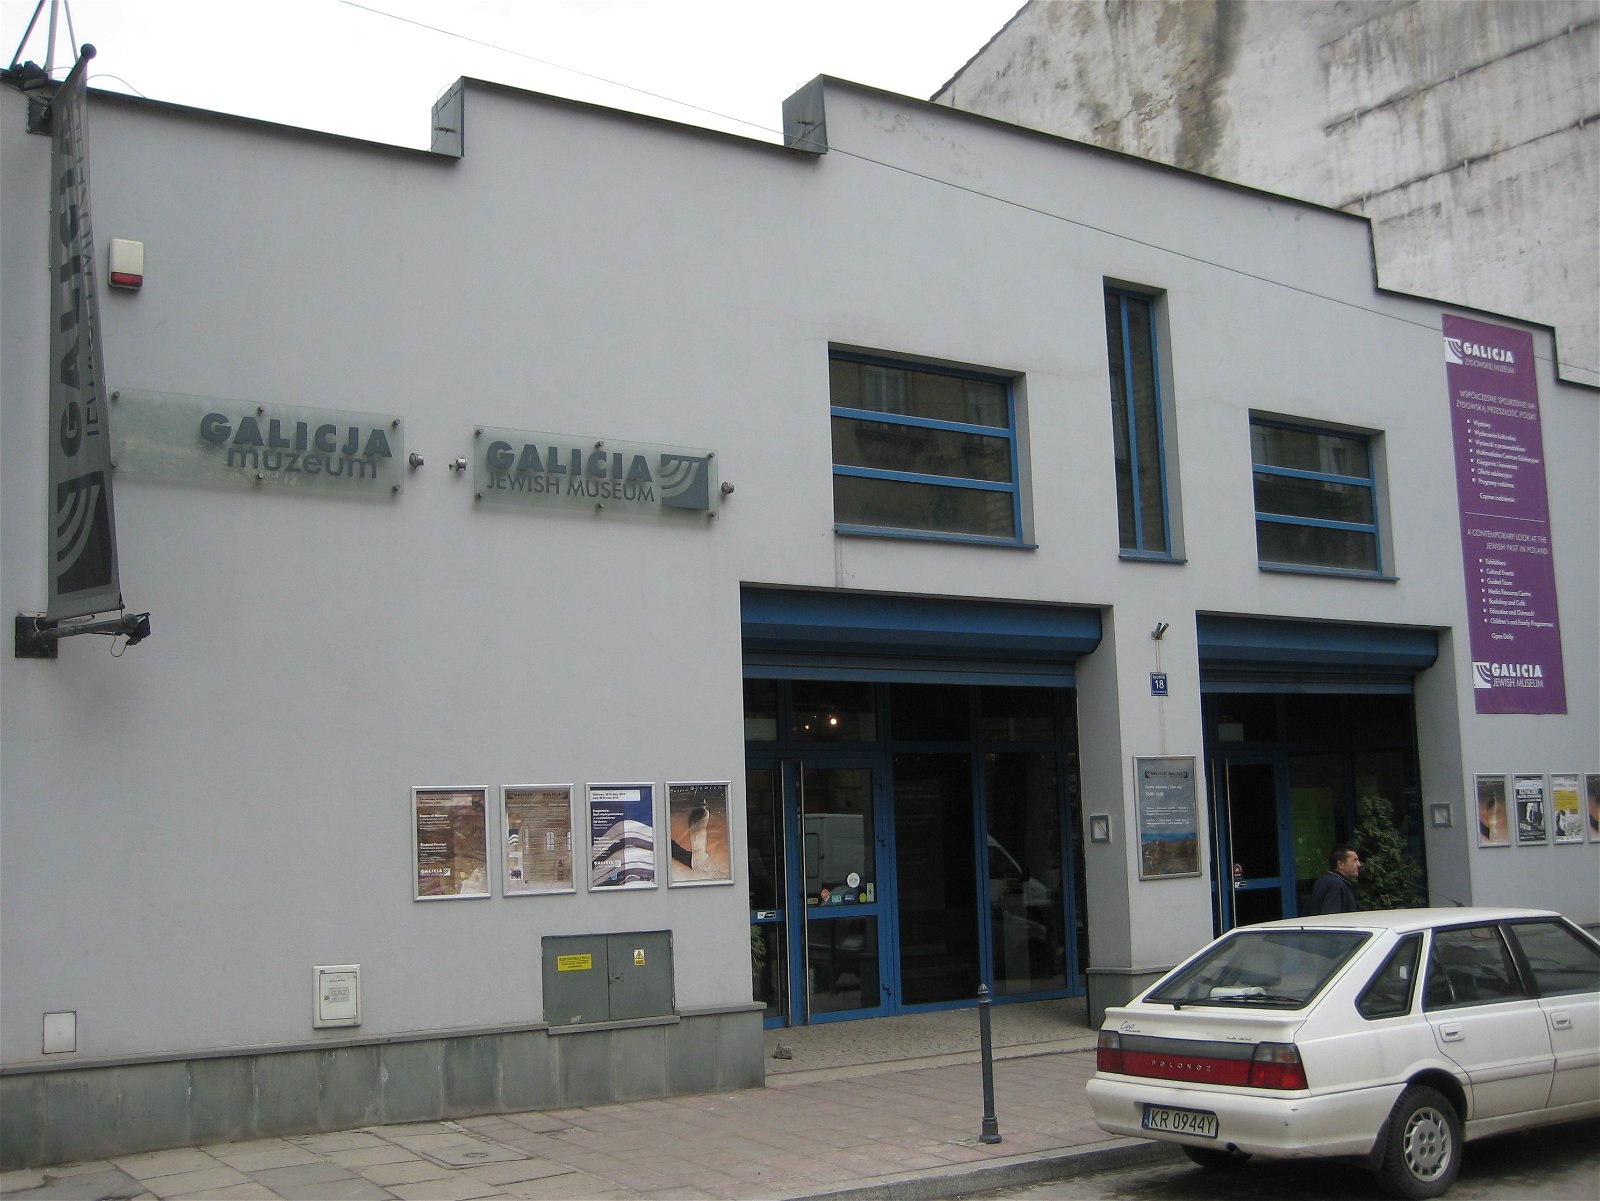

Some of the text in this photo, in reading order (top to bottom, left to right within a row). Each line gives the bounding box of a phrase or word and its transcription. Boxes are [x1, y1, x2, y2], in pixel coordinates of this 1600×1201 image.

[1463, 342, 1514, 364] GALICJA
[200, 412, 393, 458] GALICJA
[227, 447, 377, 479] muzeum
[487, 440, 653, 483] GALICIA
[487, 471, 655, 502] JEWISH MUSEUM
[1472, 529, 1515, 540] CONTEMPORARY
[1516, 533, 1530, 542] LOOK
[1530, 535, 1538, 543] AT
[1486, 542, 1506, 551] JEWISH
[1506, 544, 1519, 552] PAST
[1526, 547, 1548, 555] POLAND
[1485, 558, 1506, 566] Exhibitions
[1486, 568, 1501, 576] Cultural
[1488, 598, 1507, 606] Bookshop
[1491, 632, 1514, 641] Open Daily
[1491, 662, 1542, 678] GALICIA
[1154, 679, 1165, 689] 18
[1492, 678, 1544, 688] JEWISH MUSEUM
[331, 989, 347, 997] GAZ
[1151, 1060, 1212, 1072] POLONEZ
[1150, 1109, 1214, 1134] KR 0944Y
